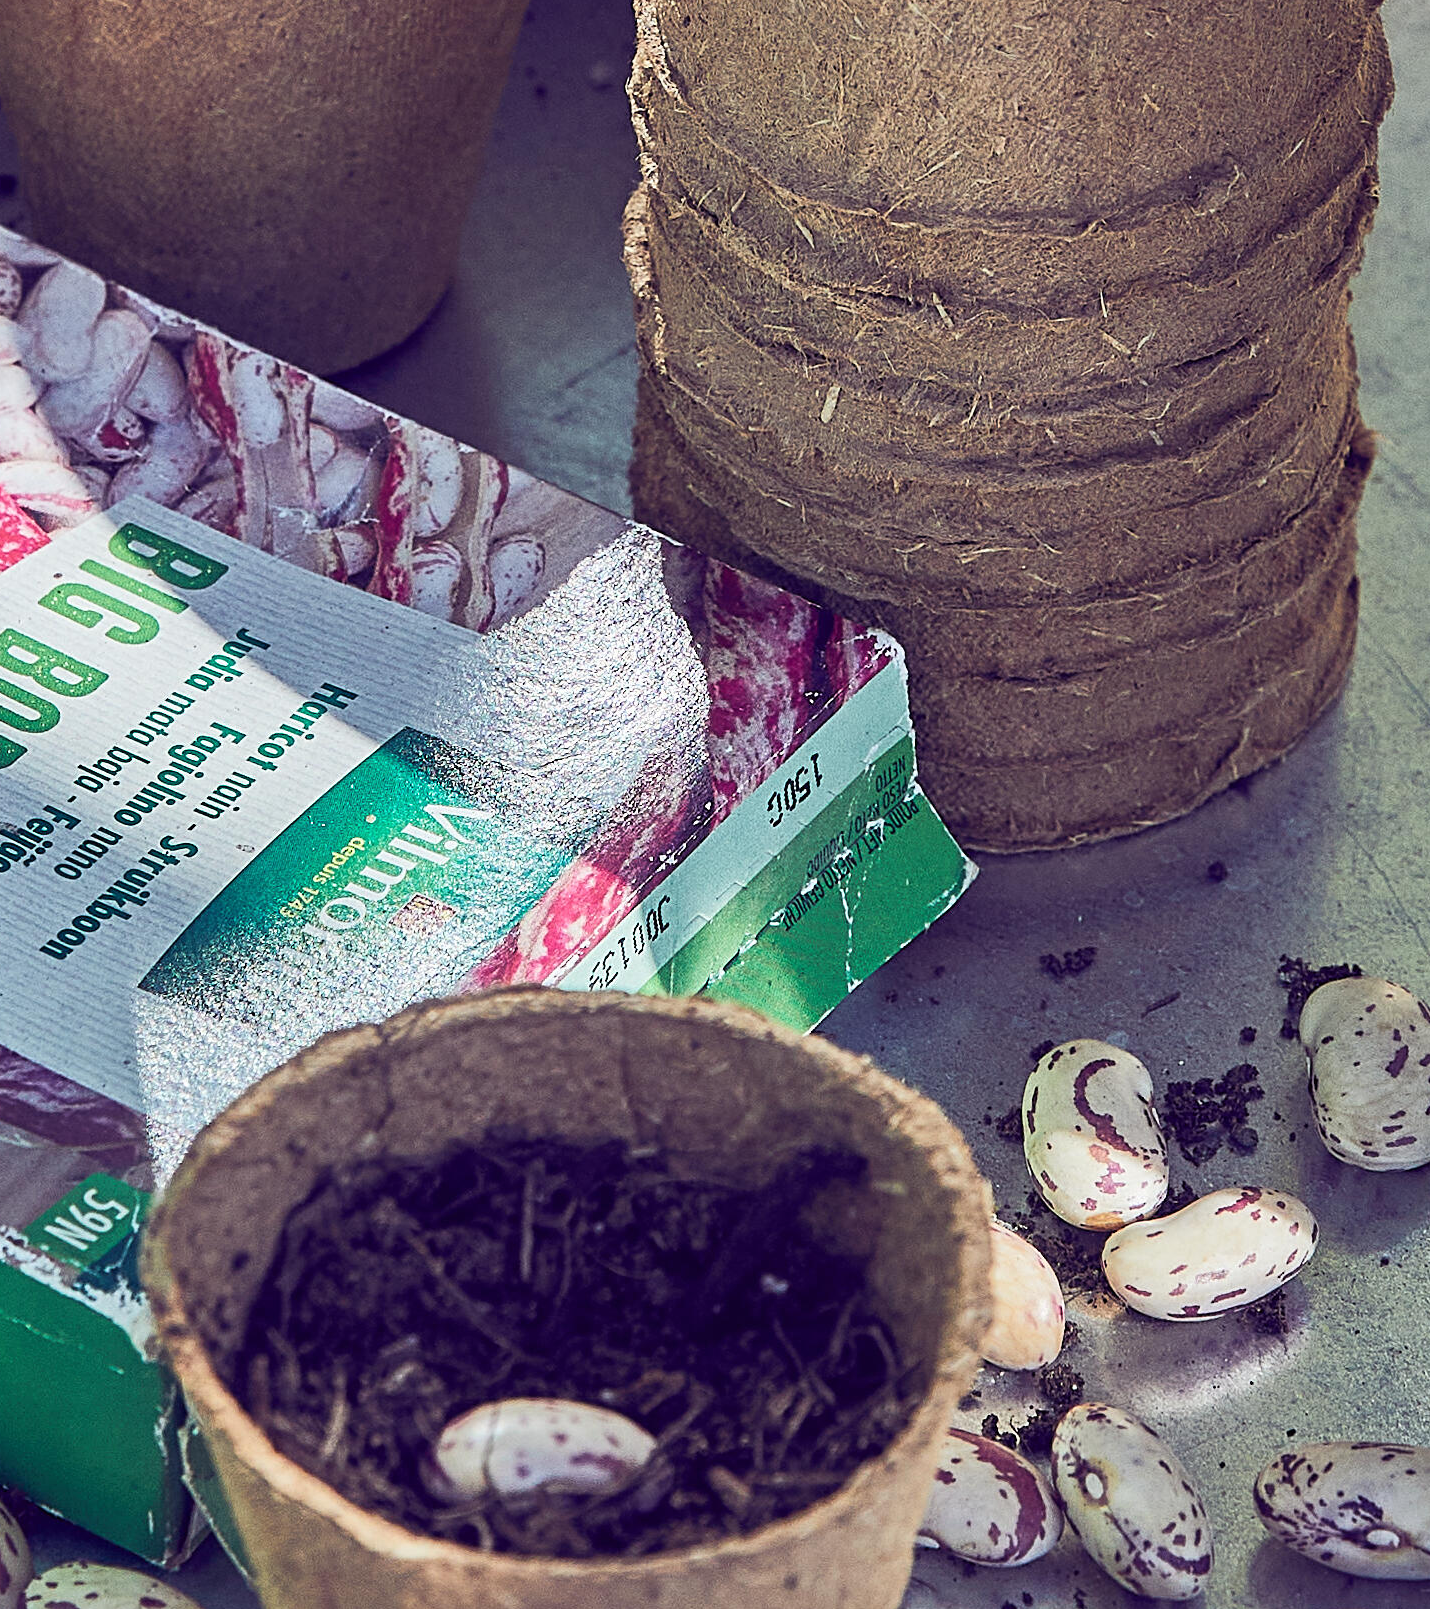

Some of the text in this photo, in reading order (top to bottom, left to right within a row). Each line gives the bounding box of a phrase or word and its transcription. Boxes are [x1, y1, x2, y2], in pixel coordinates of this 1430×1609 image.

[37, 522, 230, 645] BIG
[125, 691, 196, 747] mata
[246, 682, 359, 772] Haricot
[53, 722, 247, 880] Fagiolino nano
[73, 746, 151, 794] baja
[193, 771, 257, 820] nain
[767, 752, 823, 827] 150G
[876, 755, 906, 792] NETTO
[884, 801, 919, 835] POIDS
[38, 835, 199, 961] Struikboon
[279, 836, 366, 919] depuis 1743
[780, 886, 825, 932] GEWICHT
[44, 1188, 129, 1251] 59N
